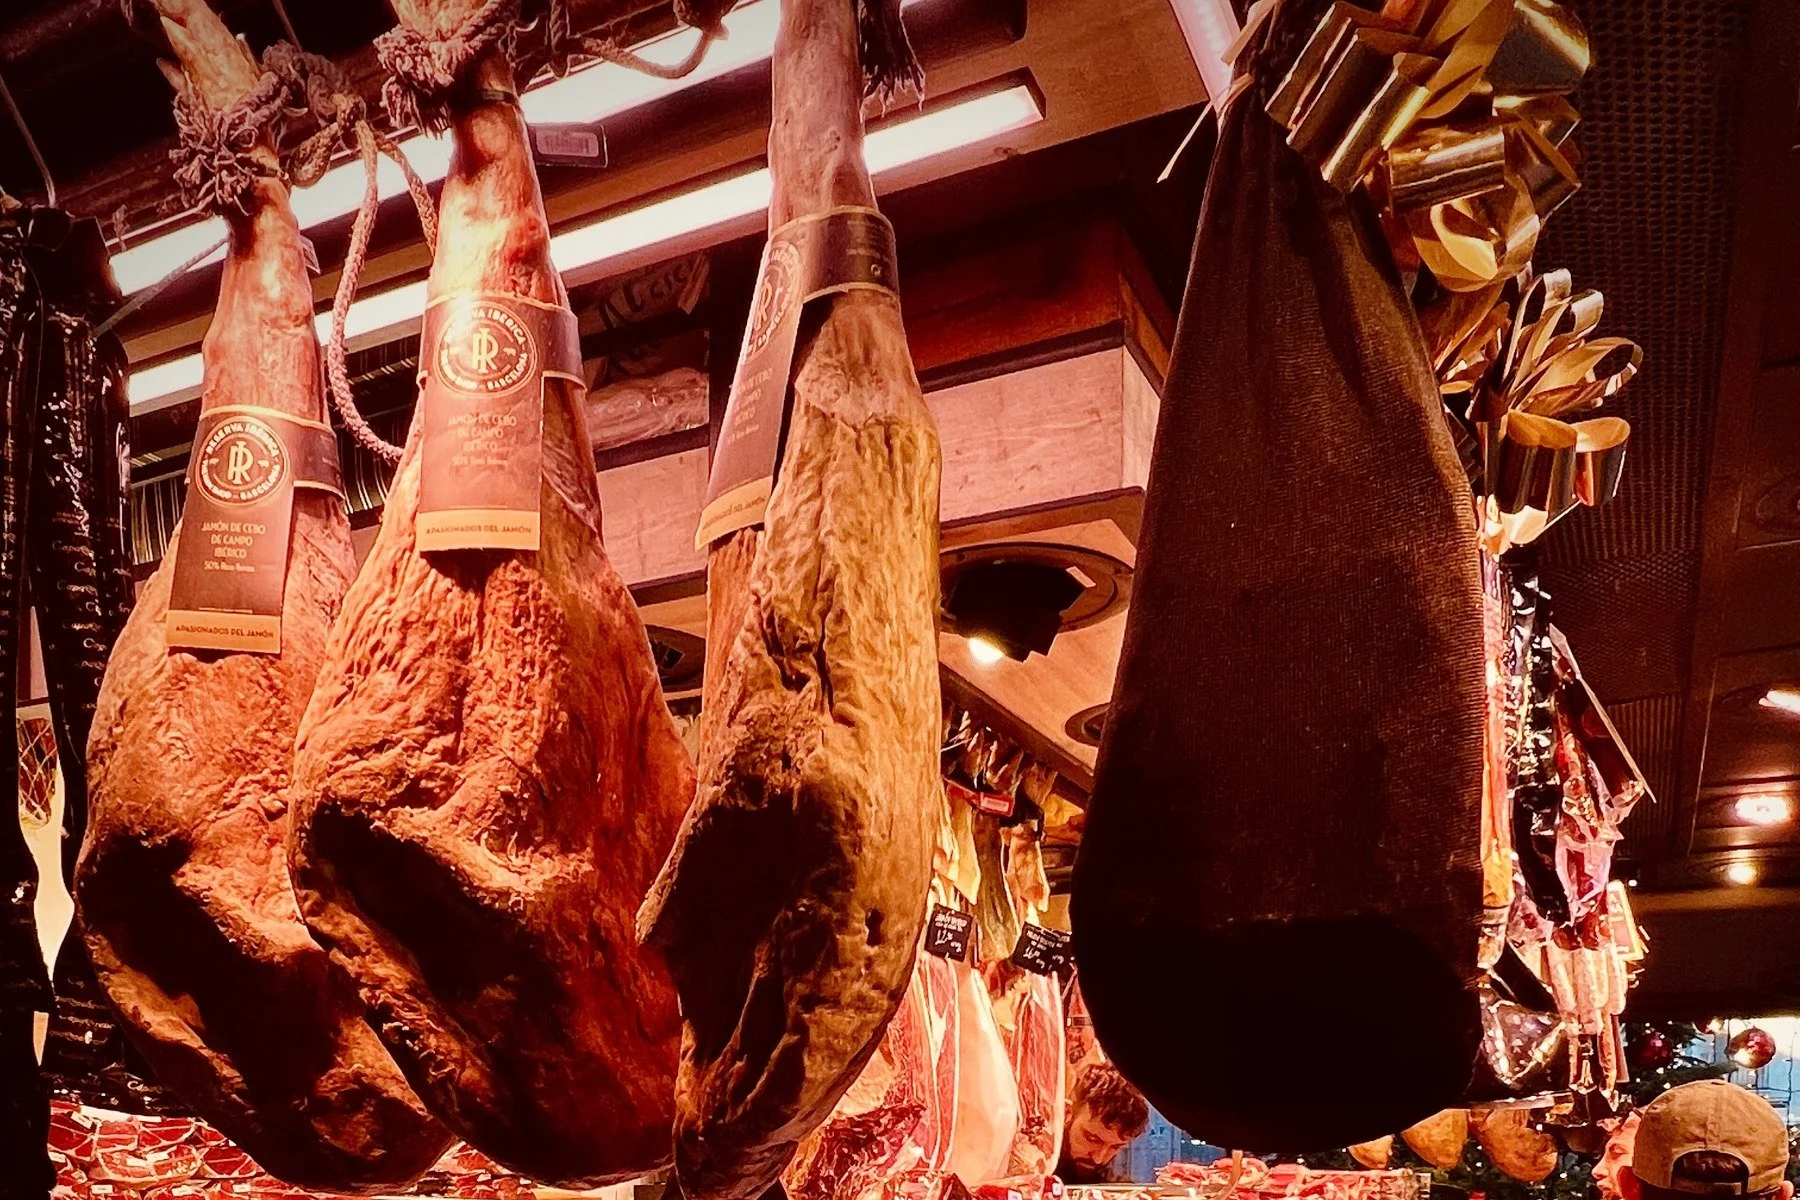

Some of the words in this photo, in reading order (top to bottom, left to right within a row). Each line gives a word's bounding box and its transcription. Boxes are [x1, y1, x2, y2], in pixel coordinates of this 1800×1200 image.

[201, 521, 230, 532] JAMÓN
[230, 522, 242, 533] DE
[242, 523, 266, 535] CEBO
[484, 525, 499, 533] DEL
[501, 524, 531, 534] JAMÓN
[211, 534, 222, 545] DE
[223, 535, 253, 547] CAMPO
[176, 624, 229, 635] APASIONADOS
[230, 628, 245, 637] DEL
[246, 629, 274, 638] JAMÓN
